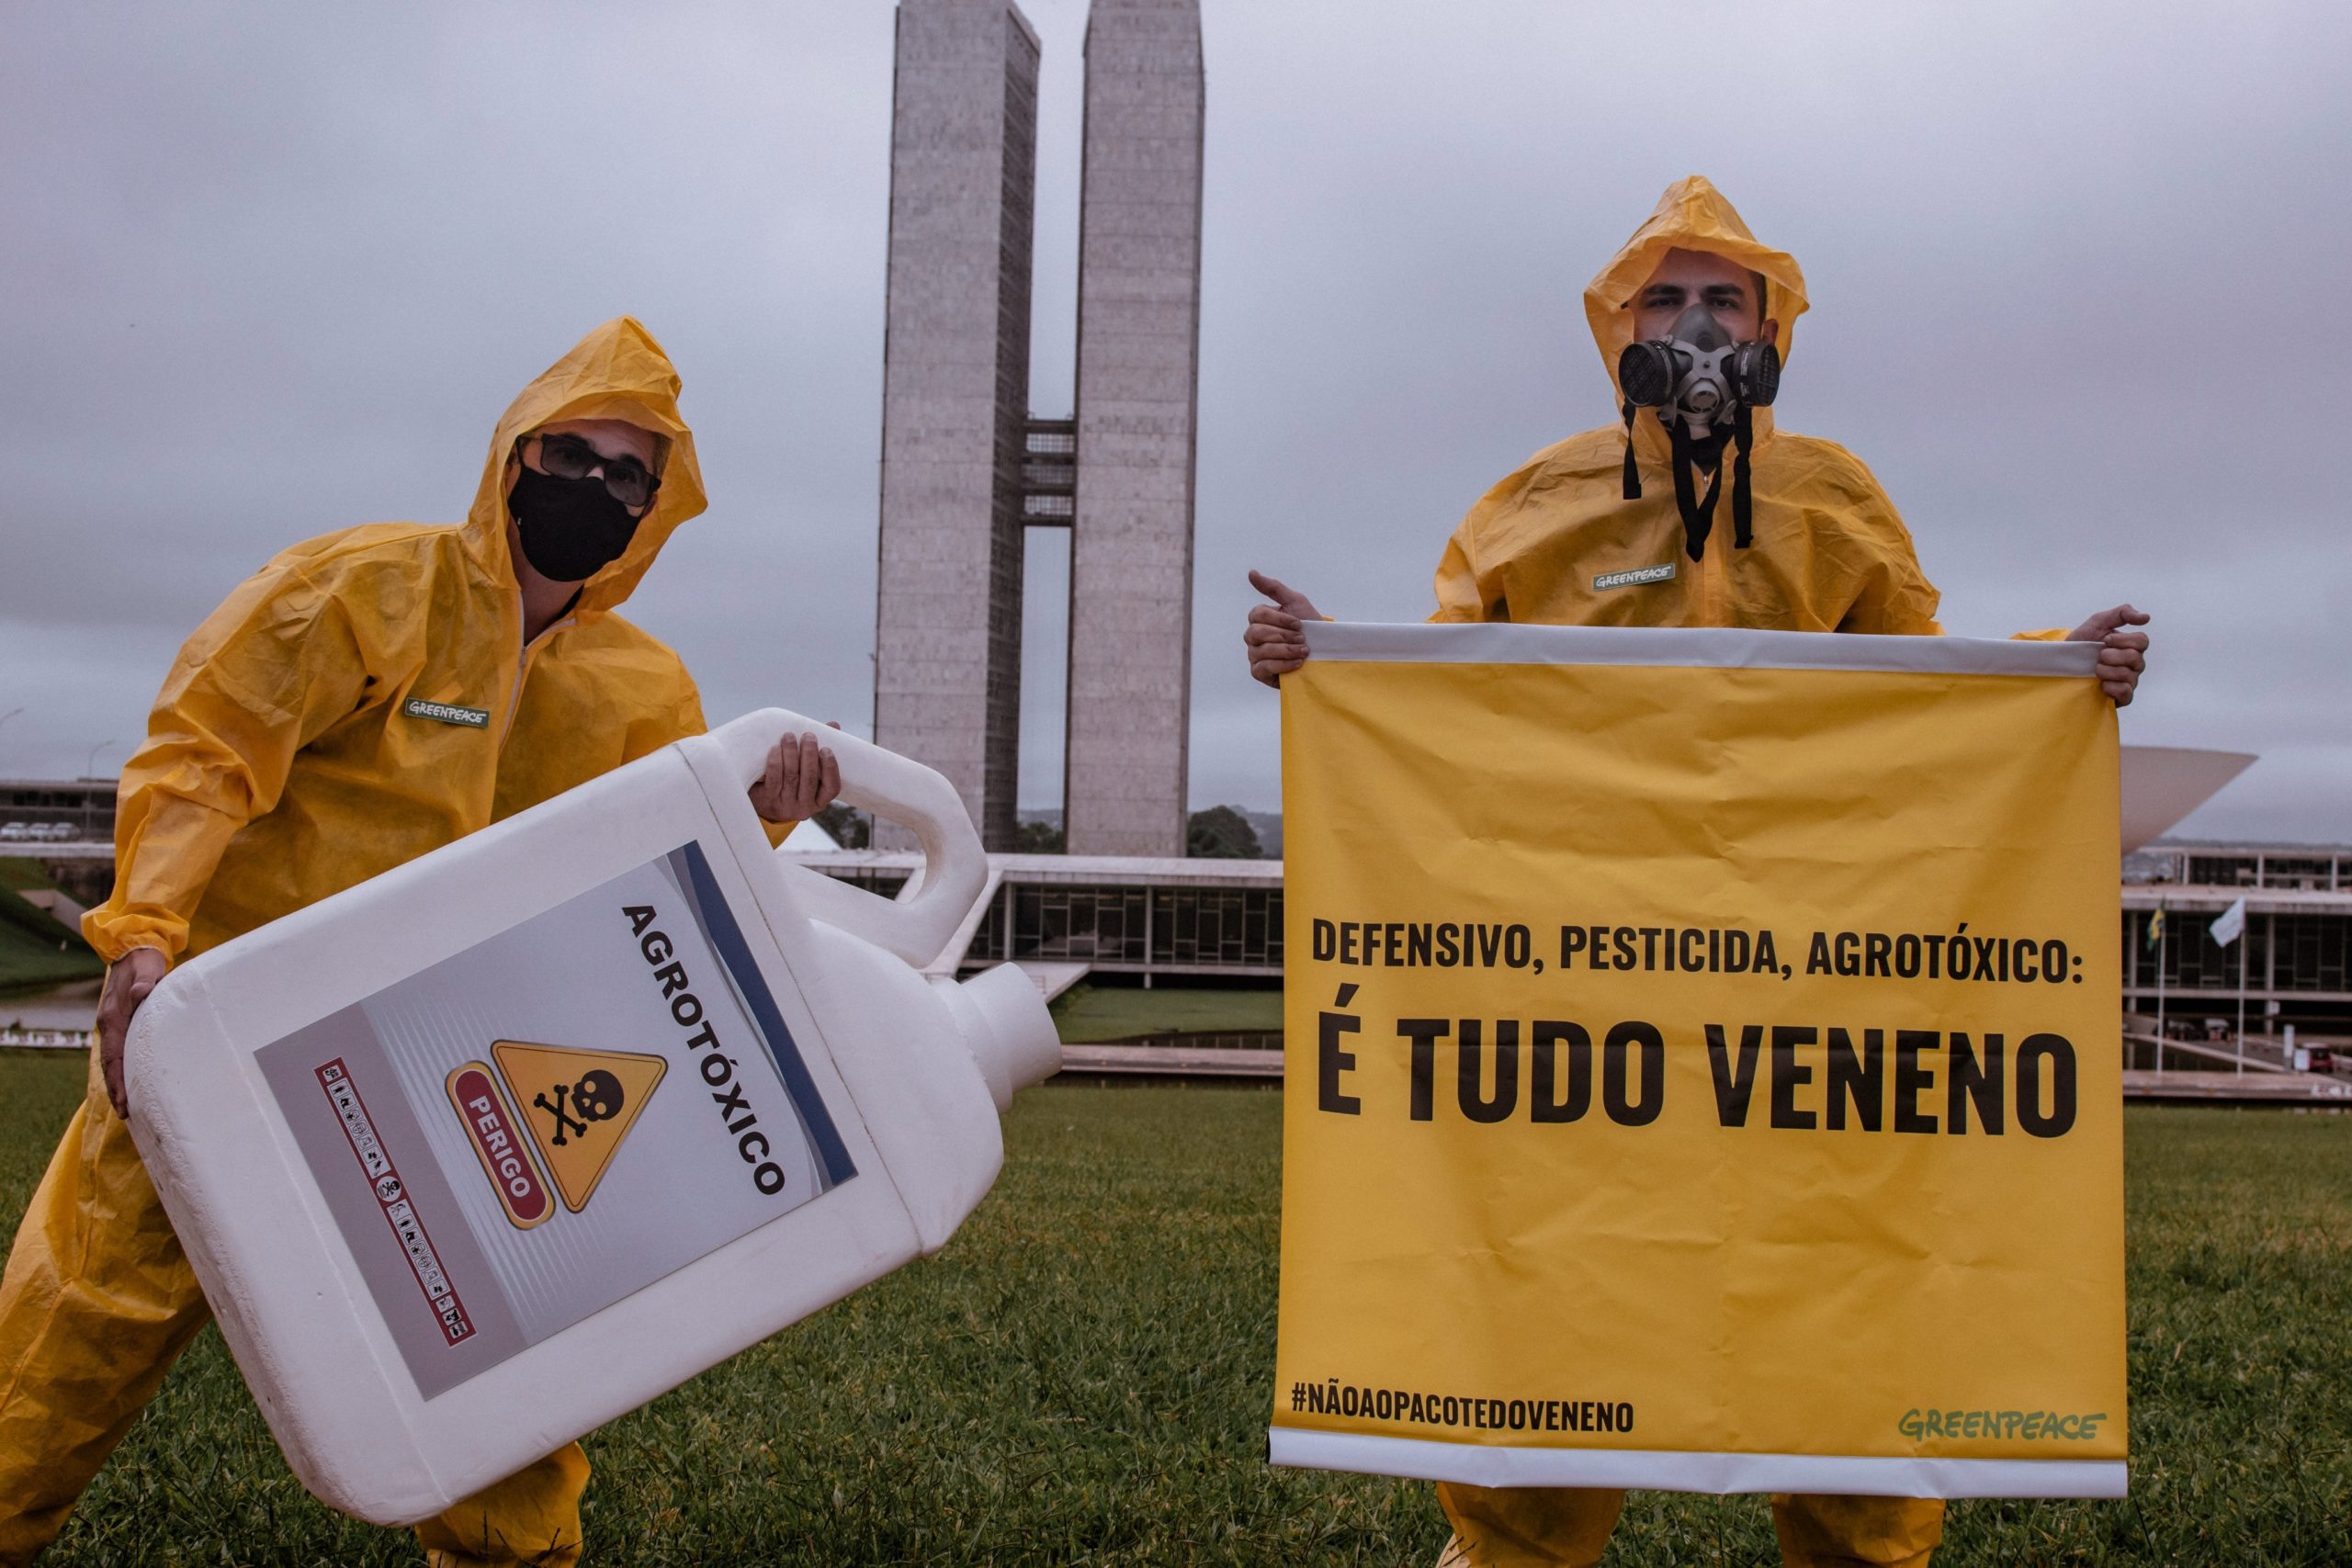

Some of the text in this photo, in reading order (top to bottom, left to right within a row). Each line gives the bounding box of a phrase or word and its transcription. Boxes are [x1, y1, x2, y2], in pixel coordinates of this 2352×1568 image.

[1596, 566, 1671, 588] GREENPEACE
[409, 701, 487, 724] GREENPEACE
[1312, 918, 2084, 984] DEFENSIVO, PESTICIDA, AGROTÓXICO:
[621, 905, 786, 1196] AGROTÓXICO
[1318, 983, 2077, 1139] É TUDO VENENO
[469, 1095, 531, 1198] PERIGO
[1291, 1378, 1634, 1433] #NÃOAOPACOTEDOVENENO
[1898, 1408, 2108, 1442] GREENPEACE
